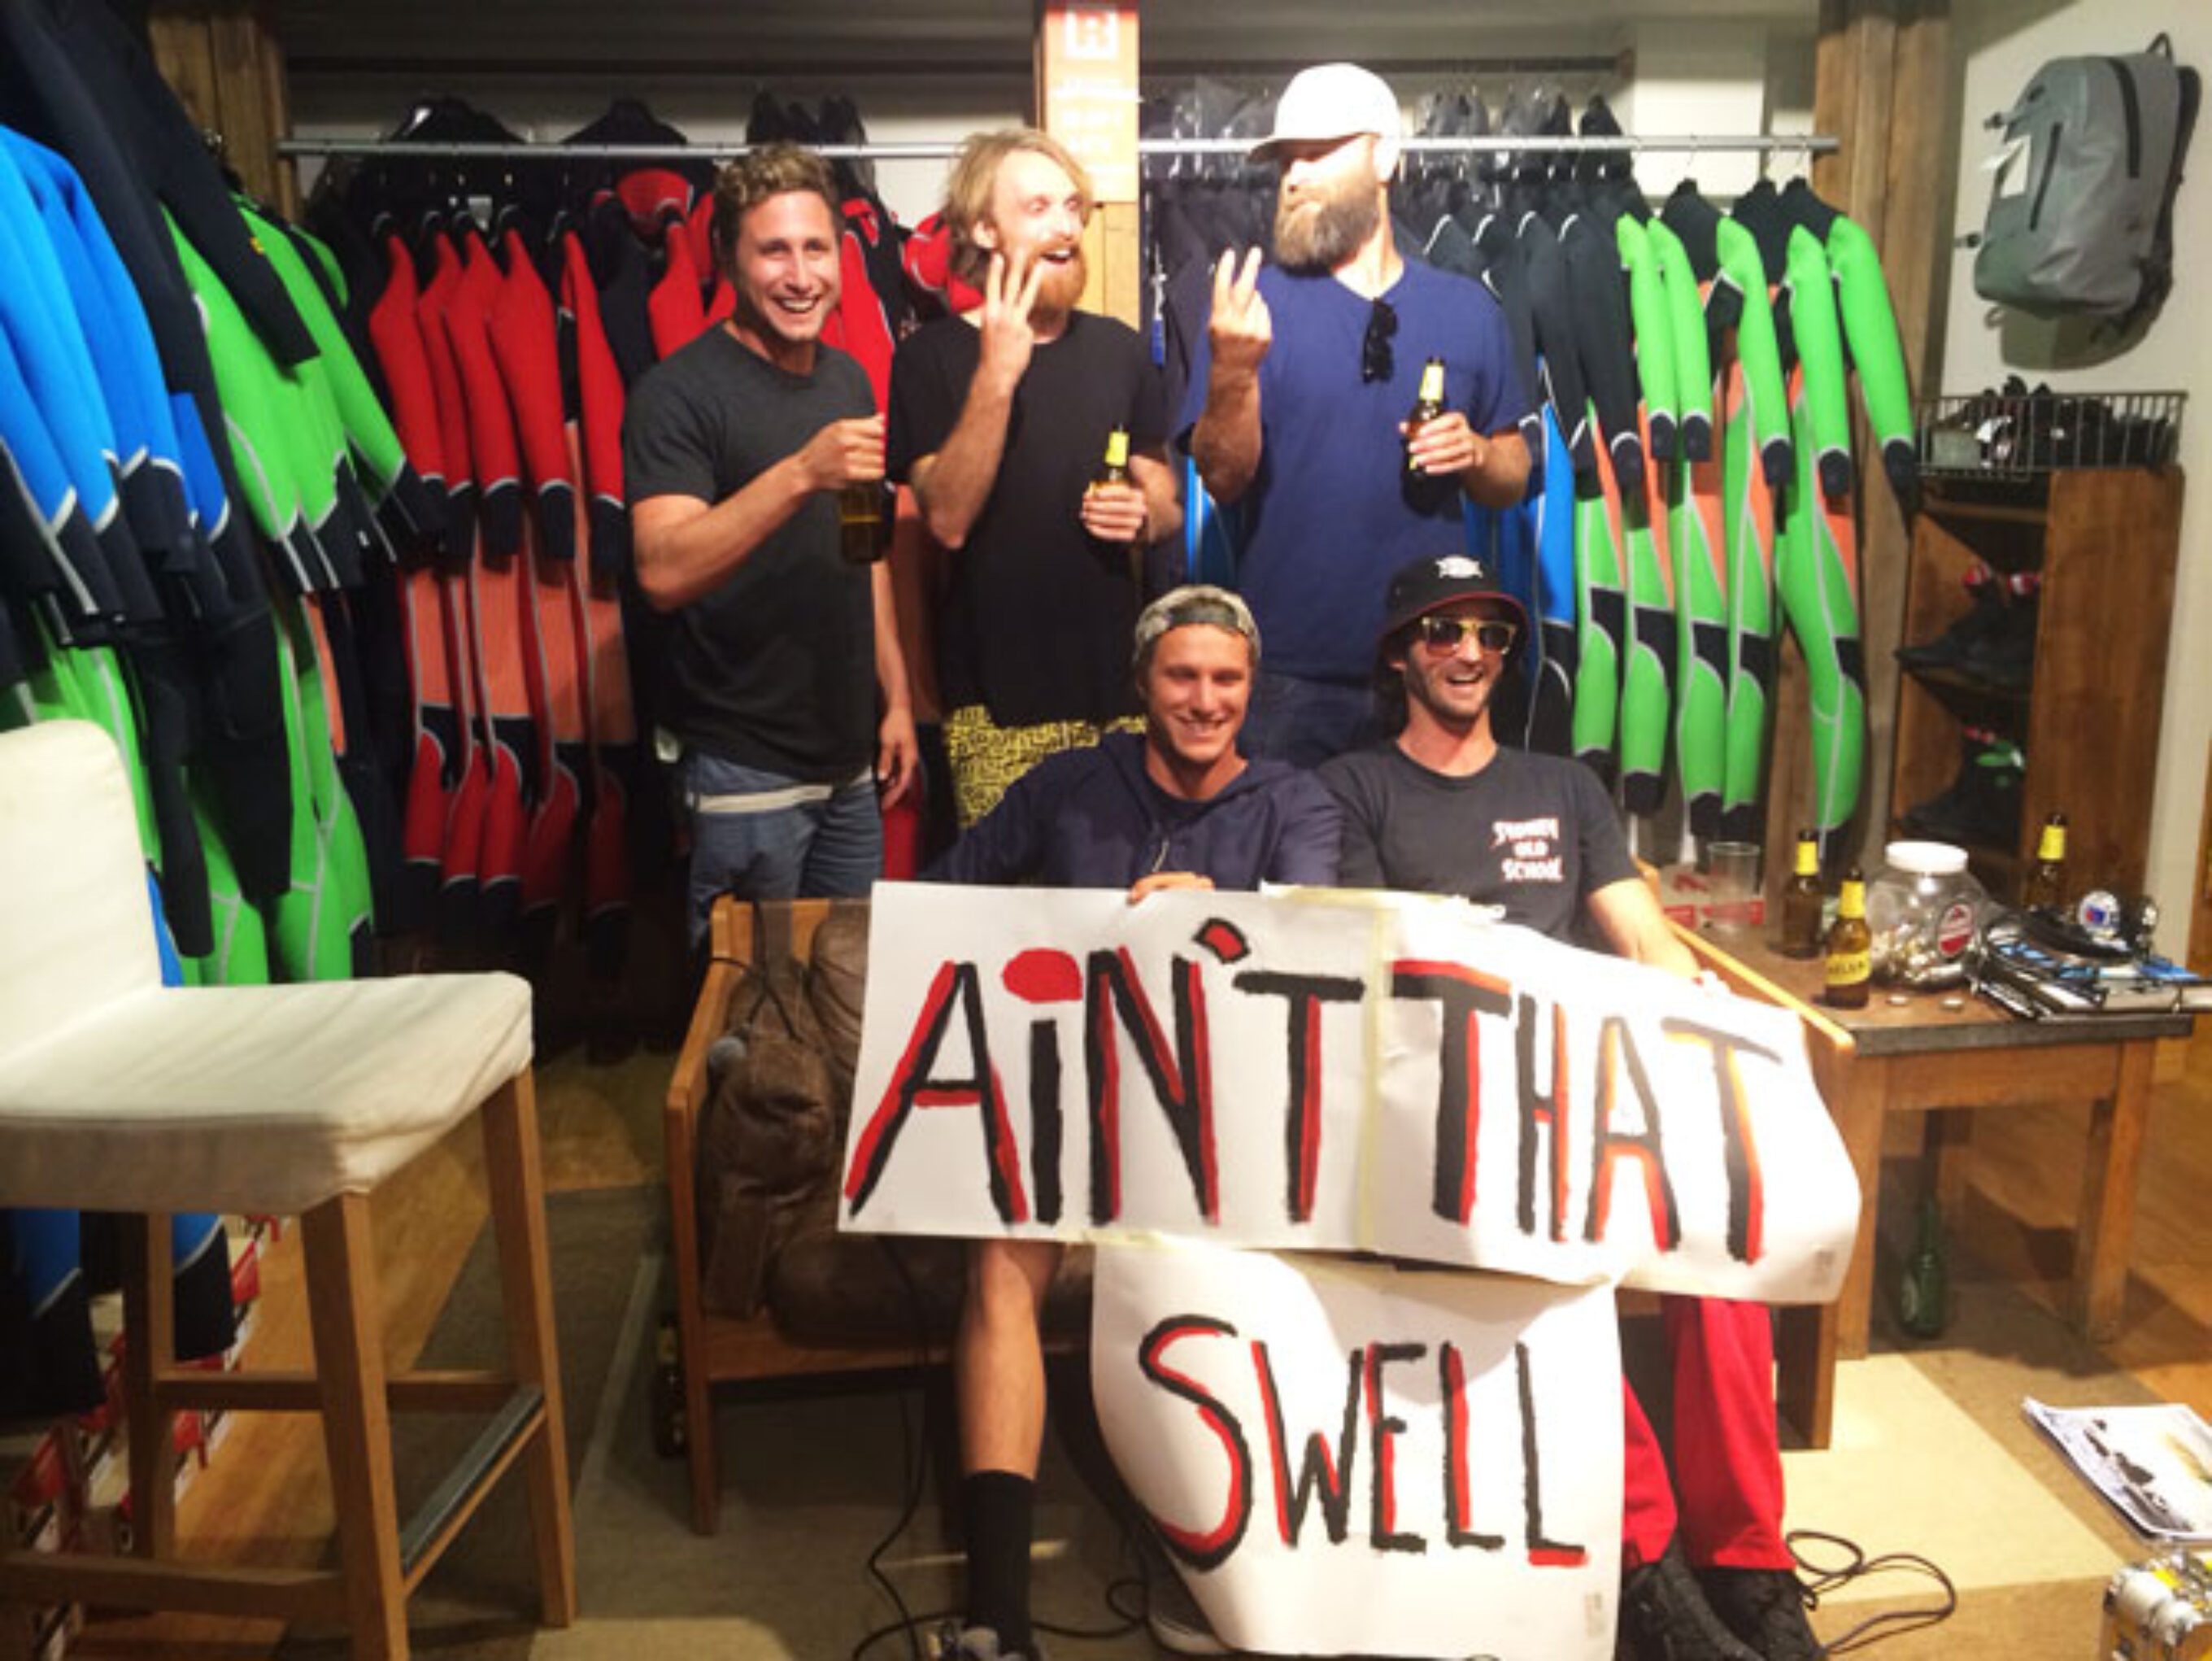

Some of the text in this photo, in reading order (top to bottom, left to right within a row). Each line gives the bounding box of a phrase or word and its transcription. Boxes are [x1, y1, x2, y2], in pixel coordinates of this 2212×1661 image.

[1500, 856, 1565, 883] SCHOOL
[1389, 957, 1783, 1266] THAT
[1138, 1313, 1589, 1572] SWELL
